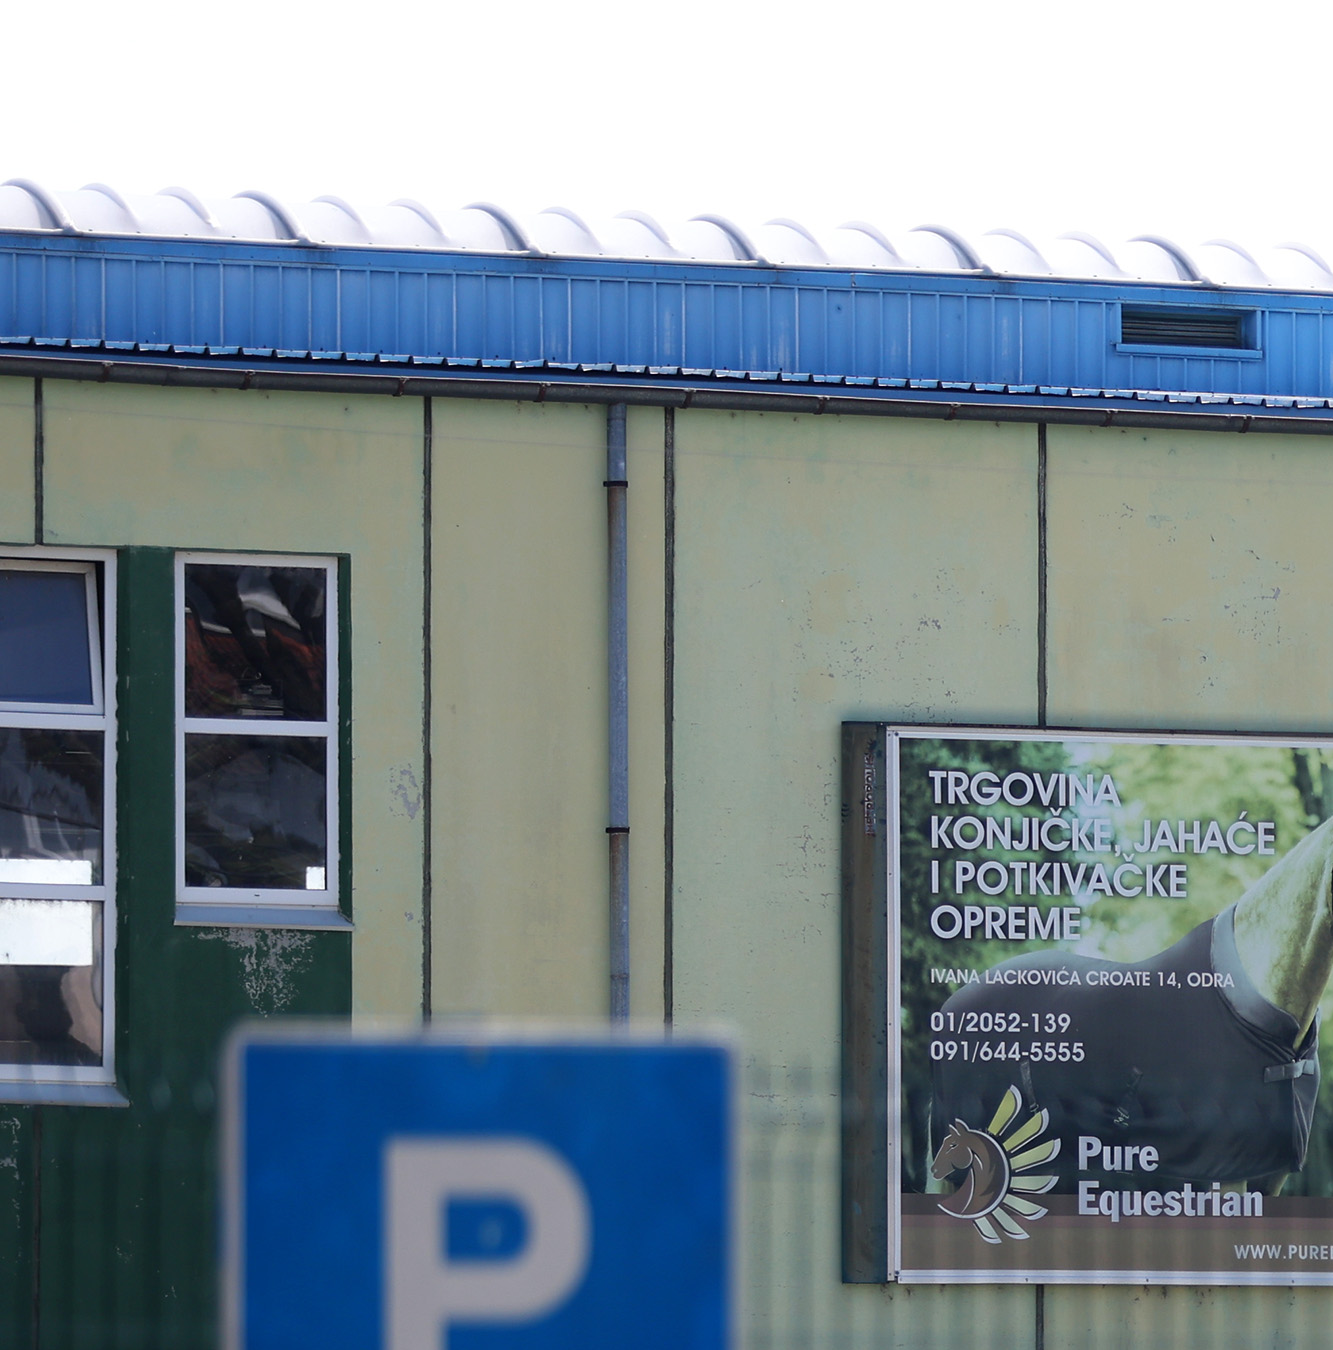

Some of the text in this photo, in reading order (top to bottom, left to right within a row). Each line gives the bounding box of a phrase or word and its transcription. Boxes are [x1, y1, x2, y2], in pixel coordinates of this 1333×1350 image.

[929, 771, 1121, 807] TRGOVINA
[931, 808, 1275, 857] KONJIČKE, JAHAĆE
[931, 853, 1187, 898] I POTKIVAČKE
[930, 905, 1081, 940] OPREME
[931, 966, 1235, 989] IVANA LACKOVIĆA CROATE 14, ODRA
[930, 1012, 1071, 1034] 01/2052-139
[930, 1040, 1085, 1063] 091/644-5555
[1078, 1136, 1159, 1171] Pure
[1078, 1180, 1263, 1222] Equestrian
